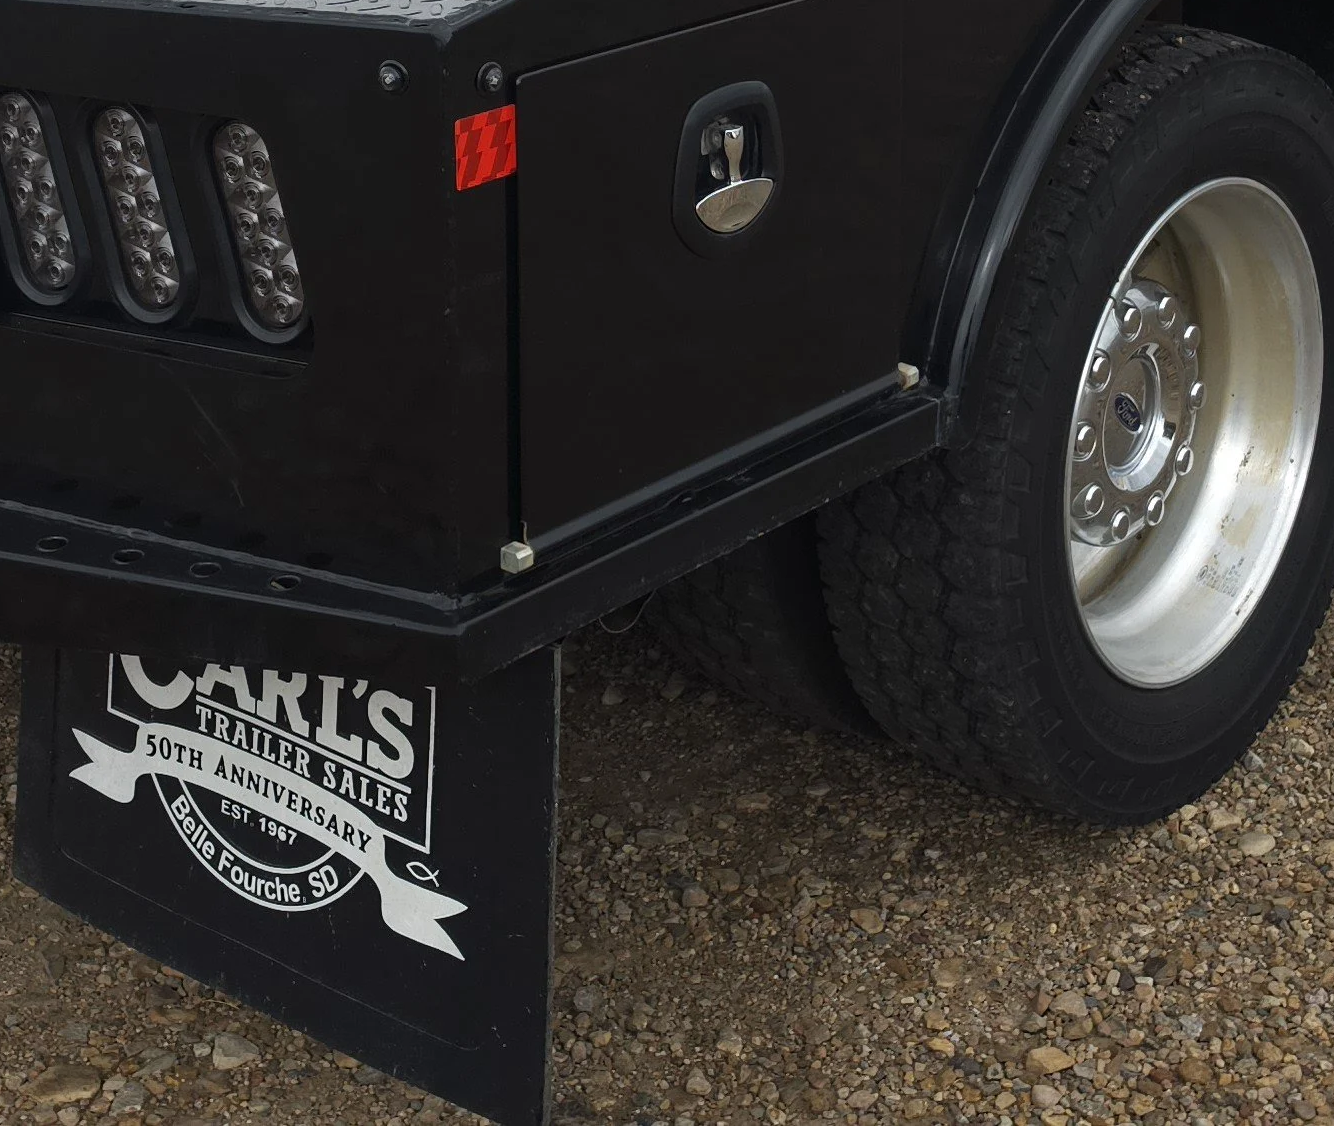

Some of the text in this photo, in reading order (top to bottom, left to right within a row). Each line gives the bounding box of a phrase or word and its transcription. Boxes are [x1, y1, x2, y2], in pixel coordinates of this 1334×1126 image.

[1117, 398, 1138, 426] Ford
[145, 734, 372, 853] 50TH ANNIVERSARY
[195, 705, 409, 822] TRAILER SALES
[170, 794, 216, 860] Belle
[308, 865, 339, 898] SD
[258, 817, 298, 846] 1967
